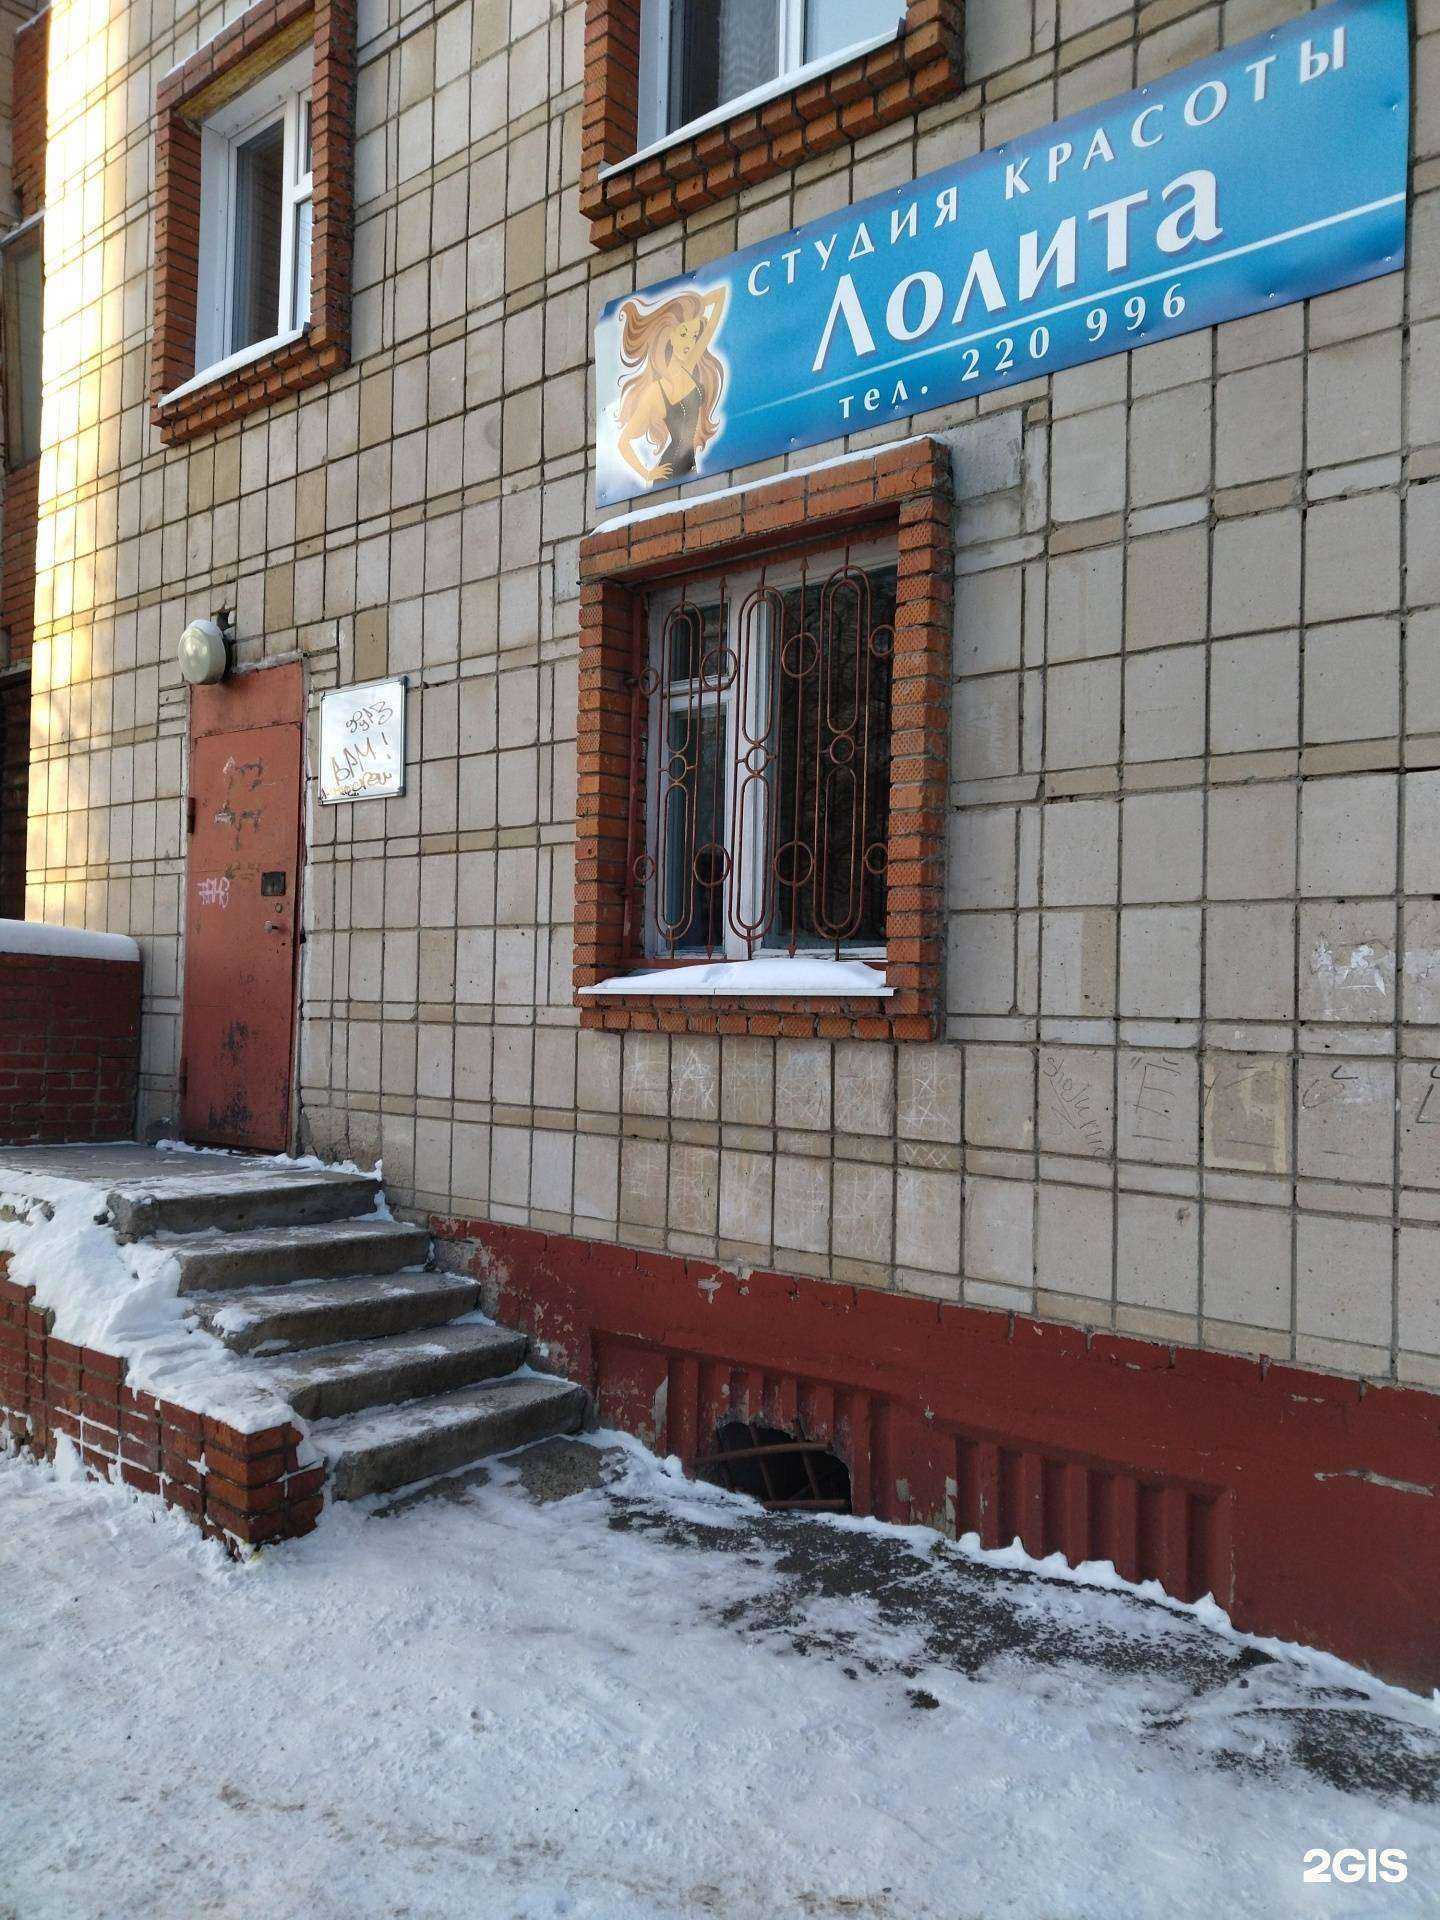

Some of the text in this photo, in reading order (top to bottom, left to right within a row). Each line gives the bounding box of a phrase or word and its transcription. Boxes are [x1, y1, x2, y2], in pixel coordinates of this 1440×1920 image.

[746, 26, 1346, 298] СТУДИЯ КРАСОТЫ
[811, 168, 1224, 373] Лолита
[837, 282, 1188, 420] тел. 220 996
